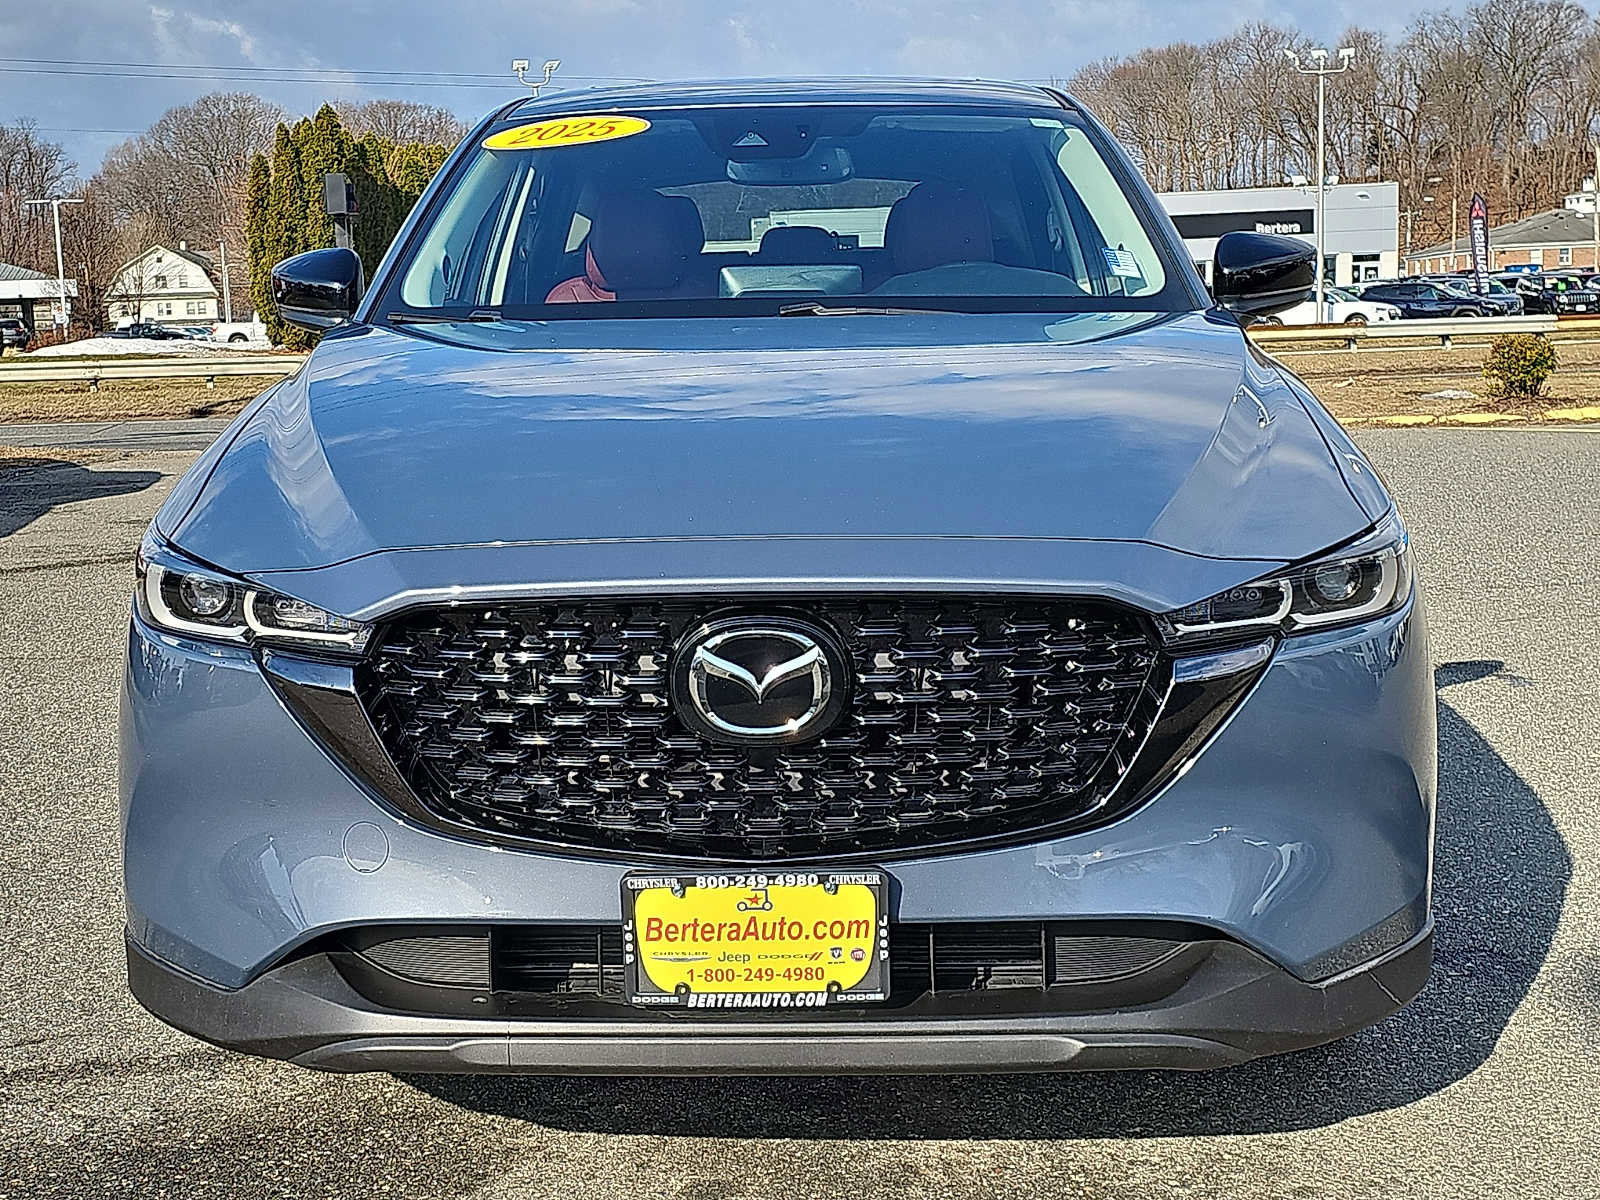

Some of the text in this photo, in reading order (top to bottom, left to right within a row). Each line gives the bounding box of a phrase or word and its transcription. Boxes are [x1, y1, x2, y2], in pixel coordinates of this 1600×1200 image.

[508, 120, 625, 146] 2025
[1255, 222, 1301, 235] Bertera
[626, 877, 679, 890] CHRYSLER
[828, 874, 881, 885] CHRYSLER
[645, 915, 870, 943] BerteraAuto.com
[623, 919, 635, 965] Jeep
[878, 914, 889, 961] Jeep
[717, 951, 751, 965] Jeep
[686, 967, 825, 983] 1-800-249-4980
[631, 996, 680, 1004] DODGE
[687, 992, 829, 1008] BERTERAAUTO.COM
[836, 993, 885, 1002] DODGE
